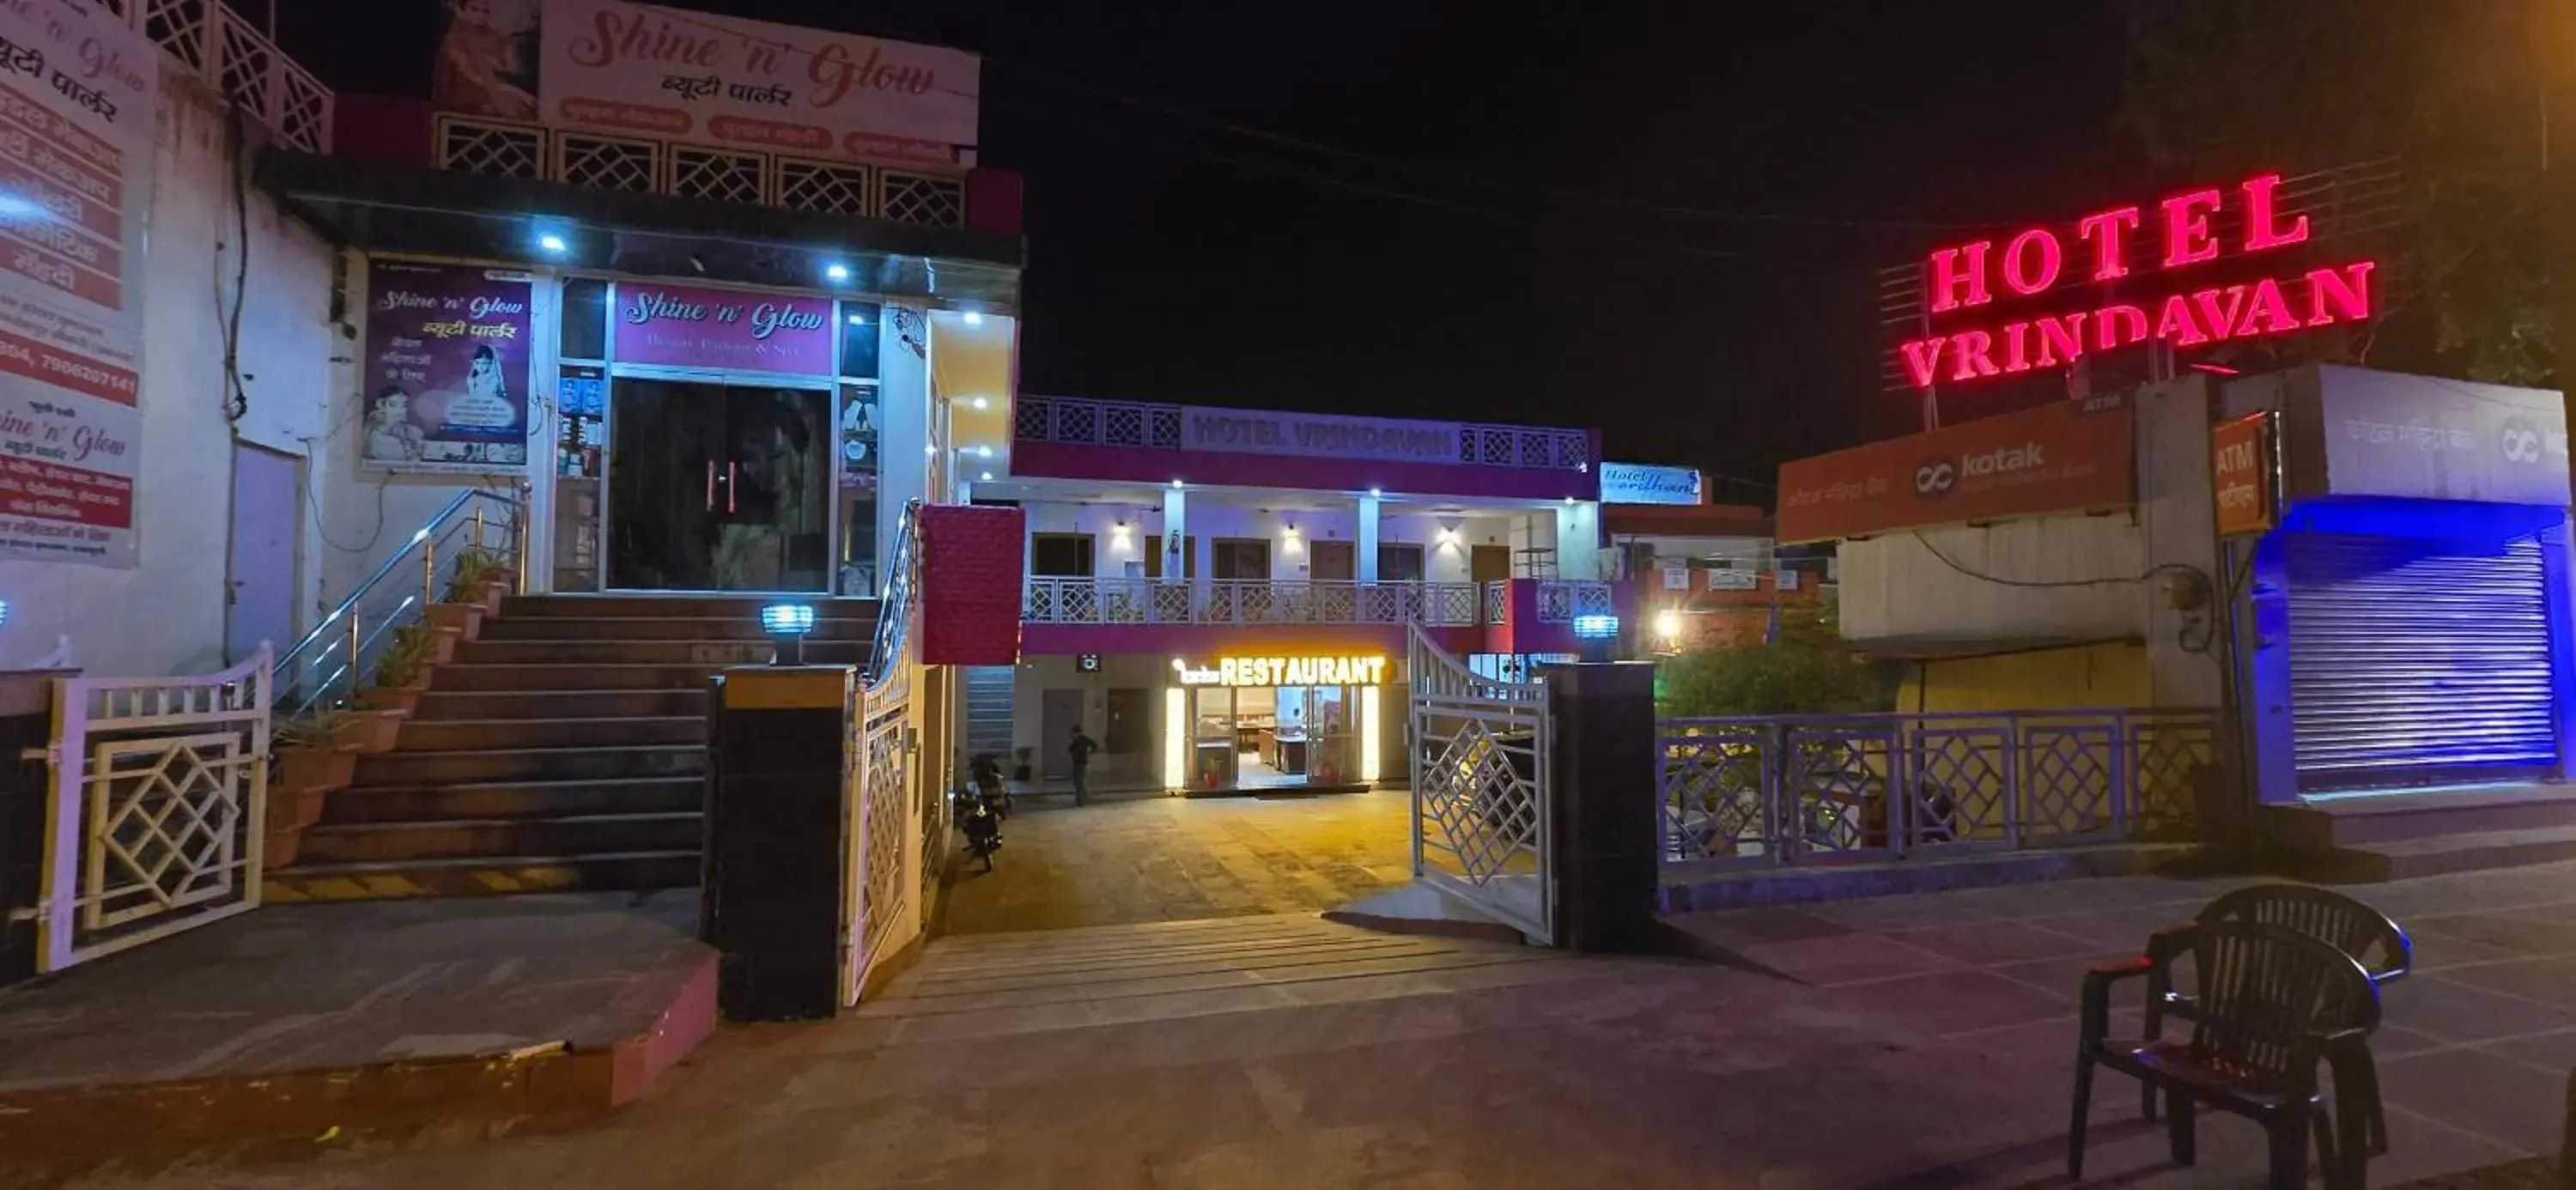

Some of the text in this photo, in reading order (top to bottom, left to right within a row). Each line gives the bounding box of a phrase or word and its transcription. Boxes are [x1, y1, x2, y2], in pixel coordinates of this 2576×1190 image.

[568, 9, 721, 68] Shine
[807, 42, 935, 108] Glow
[51, 69, 118, 124] पार्लर
[661, 74, 794, 108] ब्यूटी पार्लर
[1930, 173, 2310, 313] HOTEL
[378, 290, 438, 311] Shine
[469, 295, 523, 319] Glow
[625, 291, 825, 340] Shine 'n' Glow
[470, 322, 518, 340] पार्लर
[1900, 260, 2376, 388] VRINDAVAN
[2082, 393, 2122, 414] ATM
[0, 410, 35, 438] ine
[72, 425, 127, 461] Glow
[1192, 412, 1289, 446] HOTEL
[1960, 441, 2045, 479] kotak
[2215, 440, 2254, 477] ATM
[1219, 655, 1387, 686] RESTAURANT
